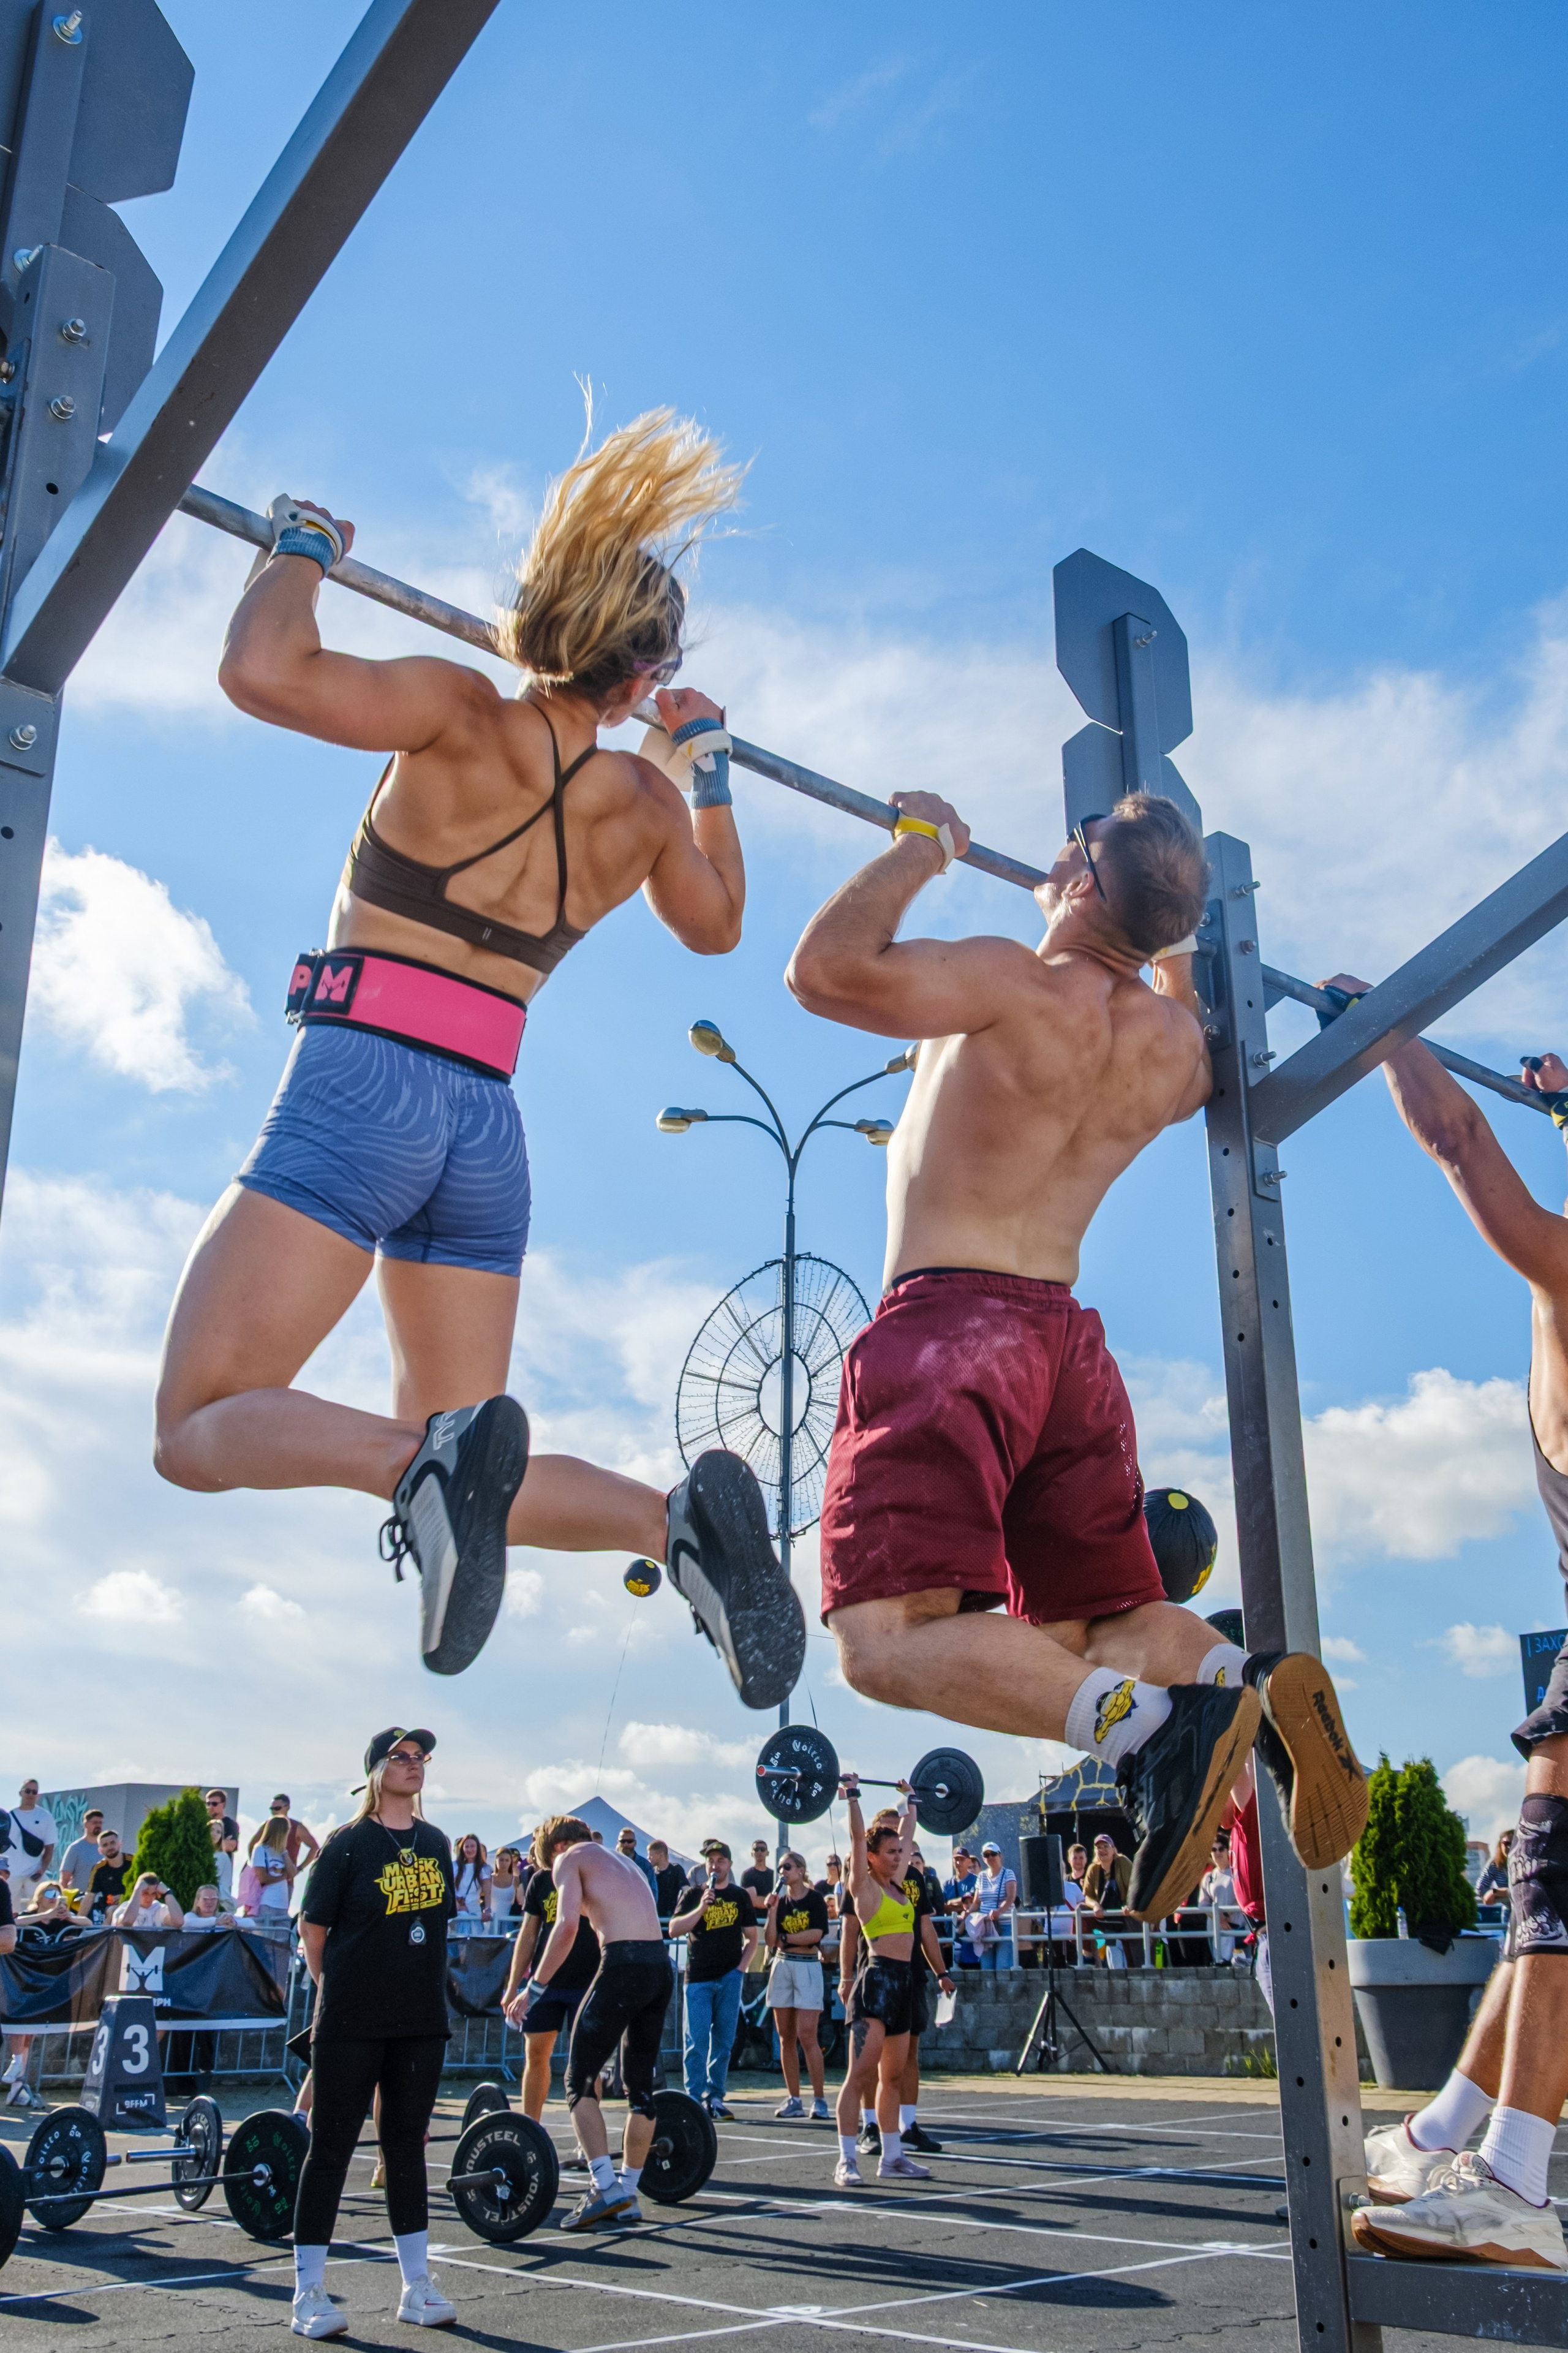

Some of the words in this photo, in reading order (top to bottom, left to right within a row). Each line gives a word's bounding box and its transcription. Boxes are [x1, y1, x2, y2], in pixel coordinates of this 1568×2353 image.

[1534, 1634, 1566, 1653] ЗАХО
[1312, 1689, 1343, 1751] Reebok
[769, 1757, 779, 1767] KG
[384, 1871, 442, 1892] URBAN
[391, 1884, 440, 1910] FEST
[92, 2025, 109, 2075] 3
[123, 2024, 149, 2074] 3
[466, 2130, 521, 2174] OUSTEEL
